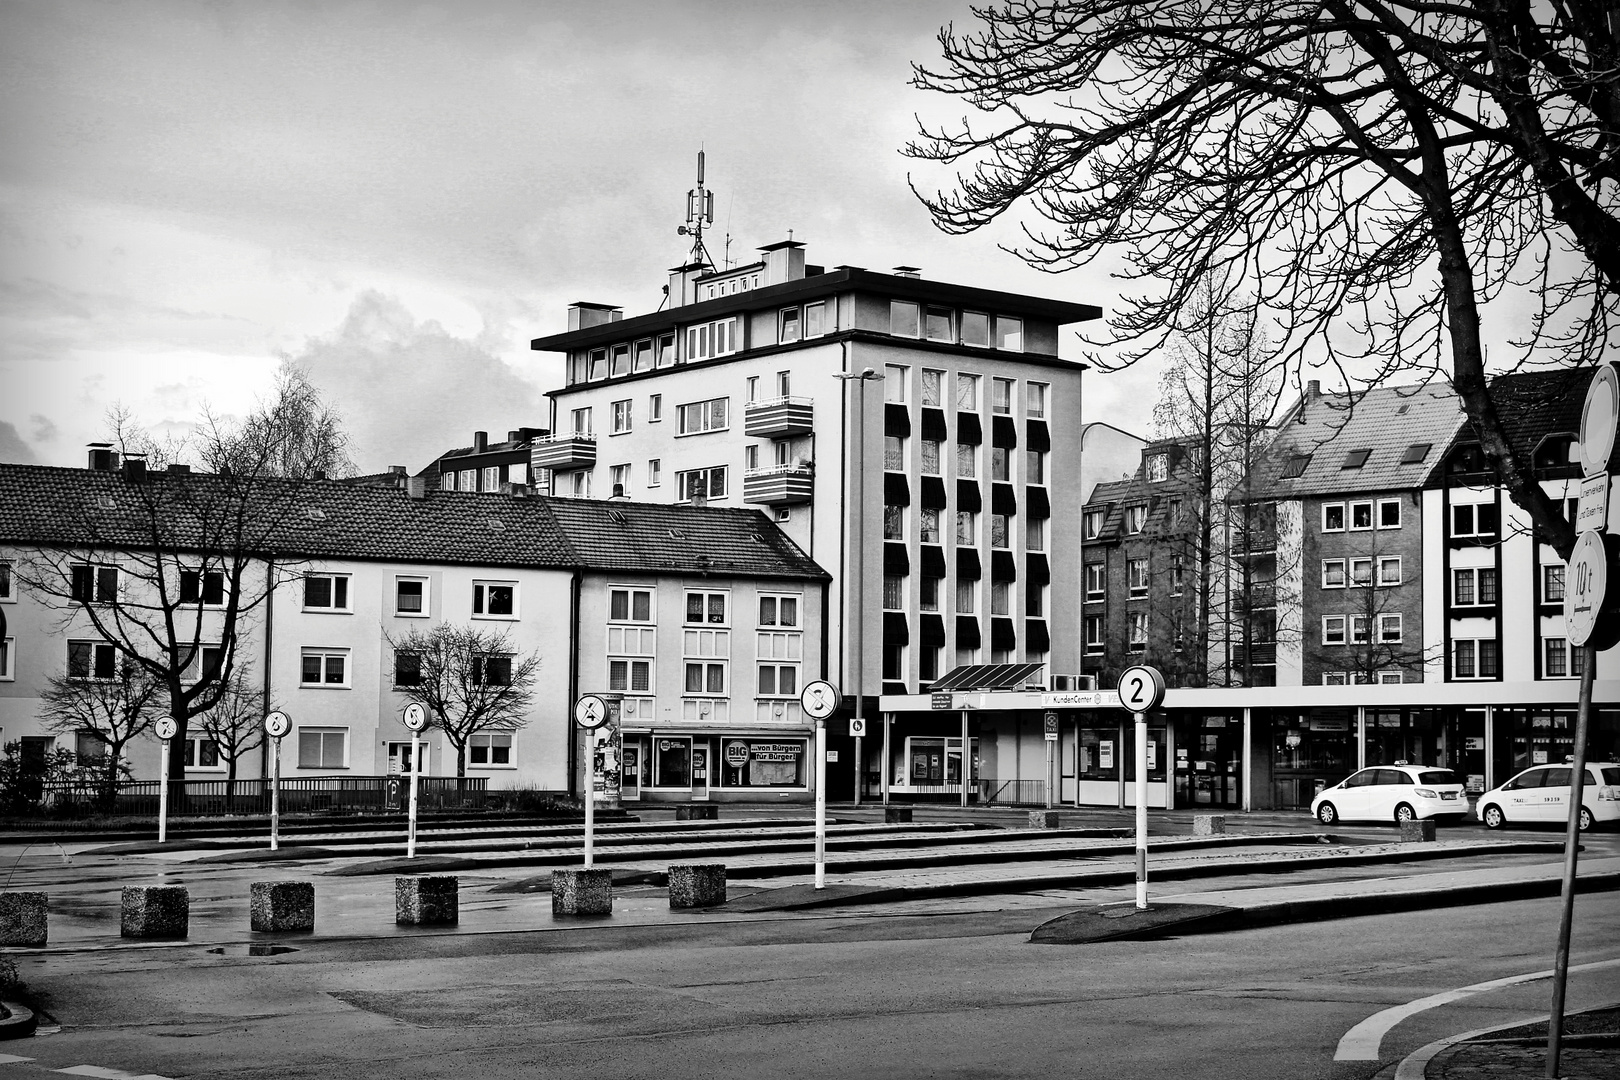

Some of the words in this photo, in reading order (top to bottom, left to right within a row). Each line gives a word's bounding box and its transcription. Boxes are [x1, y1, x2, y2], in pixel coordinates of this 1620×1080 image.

[1576, 561, 1587, 596] 10
[1587, 567, 1593, 593] t
[1131, 677, 1143, 703] 2
[1053, 694, 1093, 704] KundenCenter
[729, 746, 747, 756] BIG
[772, 744, 801, 753] Bürgern
[768, 753, 796, 761] Bürger!
[391, 783, 397, 801] P
